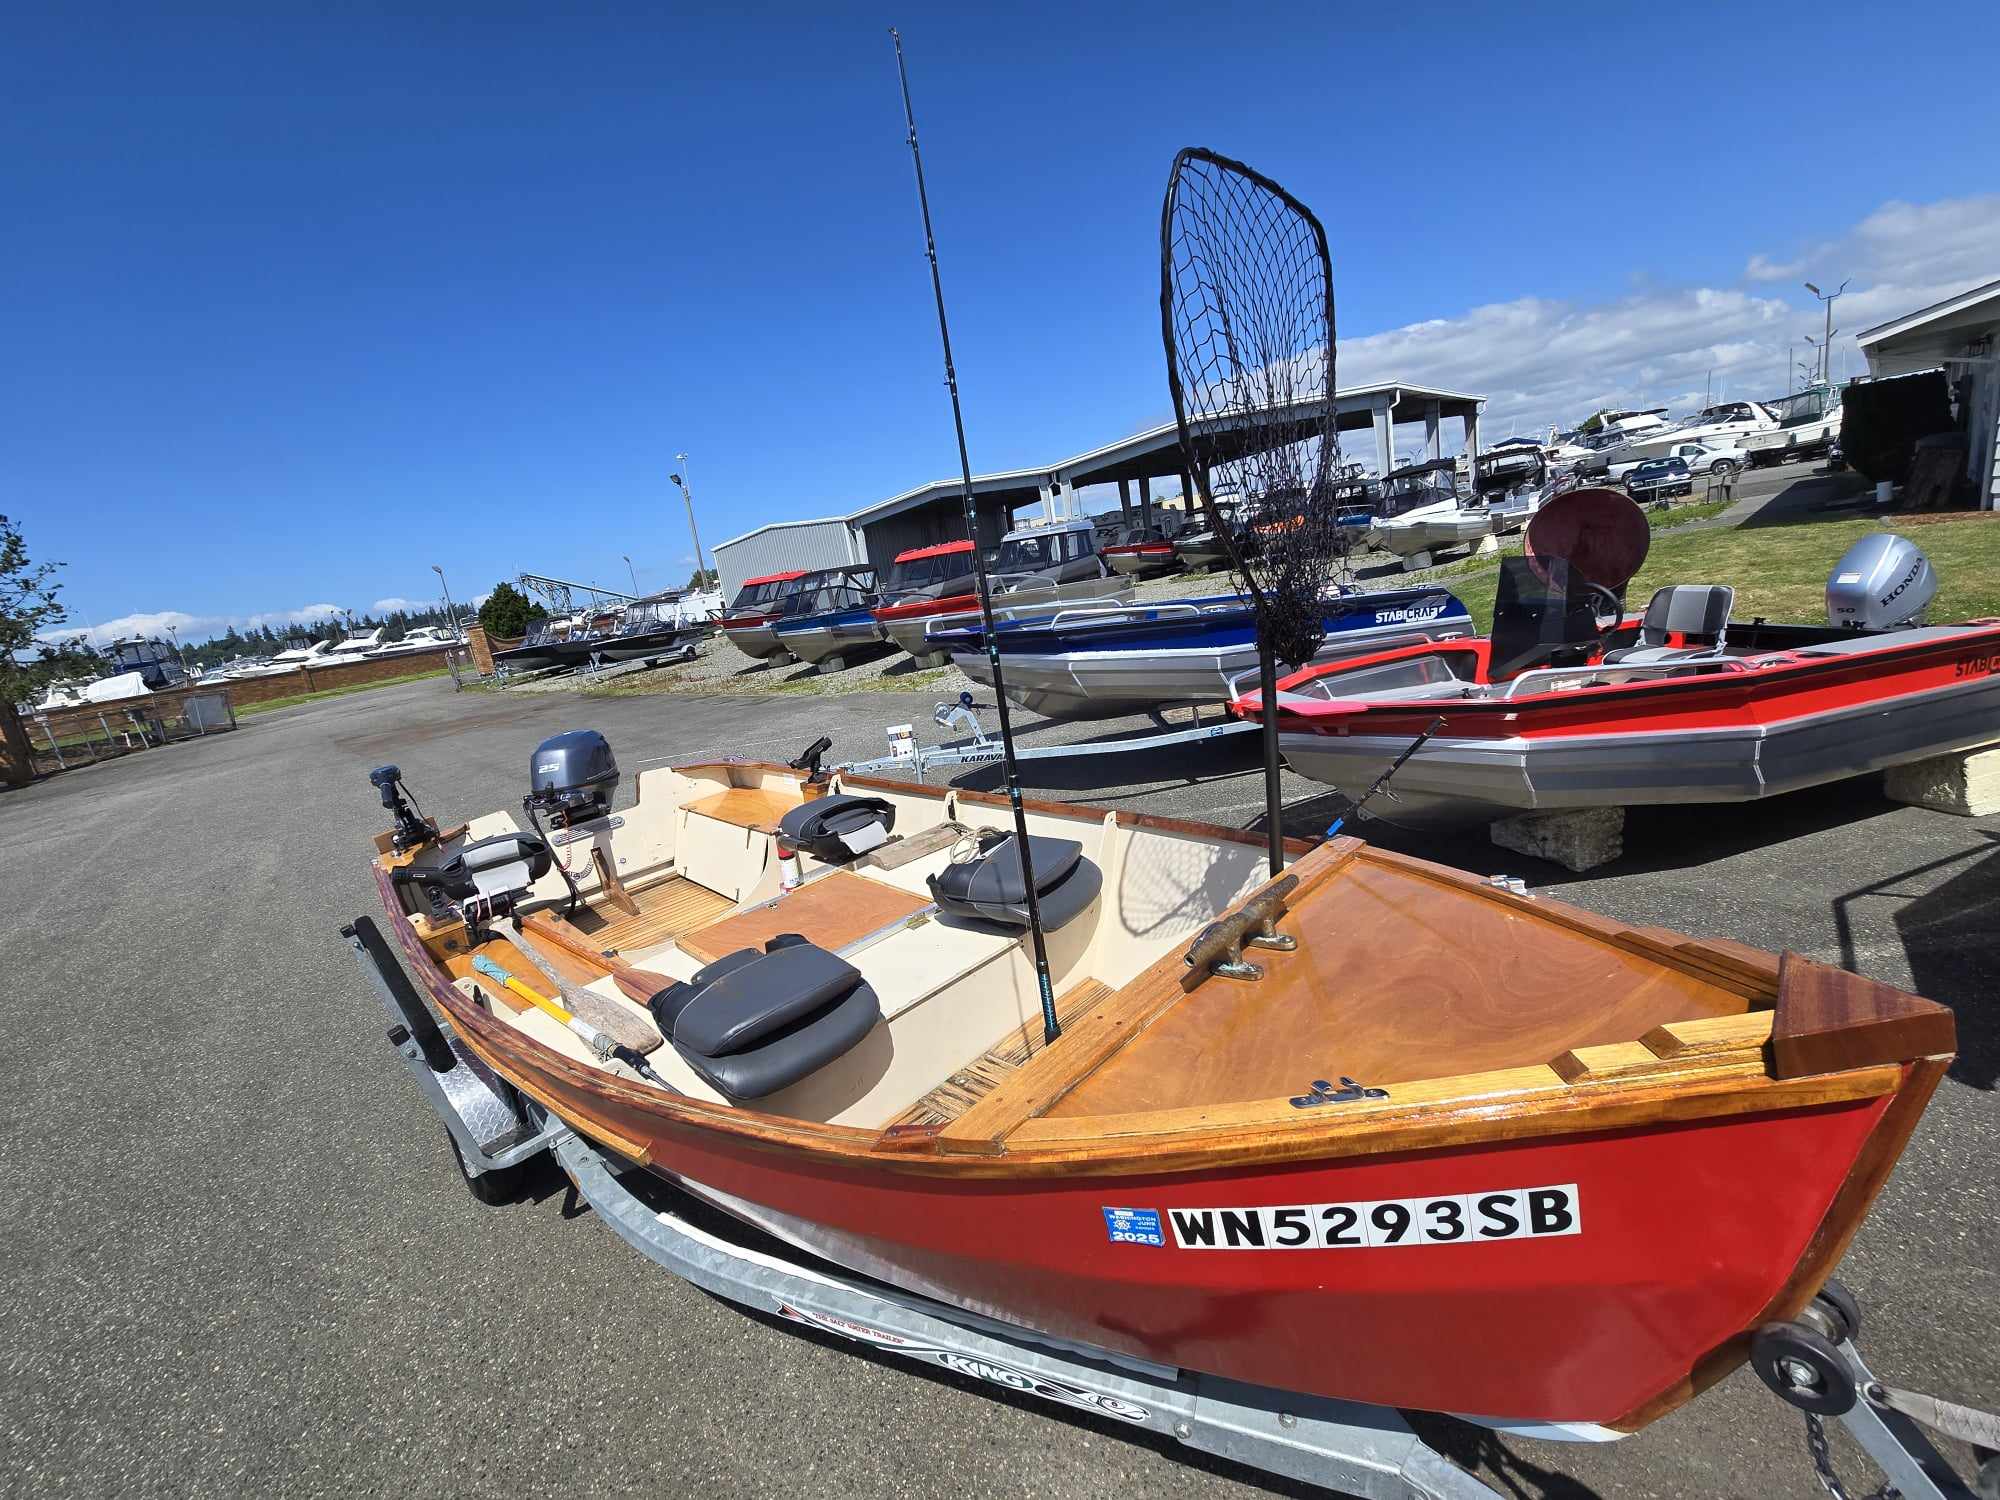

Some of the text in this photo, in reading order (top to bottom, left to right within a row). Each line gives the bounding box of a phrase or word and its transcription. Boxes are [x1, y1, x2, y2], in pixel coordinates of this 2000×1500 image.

[1880, 557, 1922, 608] HONDA
[538, 763, 560, 774] 25
[960, 752, 1005, 763] KARAVA
[1171, 1189, 1574, 1247] WN5293SB
[1112, 1231, 1160, 1244] 2025
[946, 1354, 1024, 1388] KING
